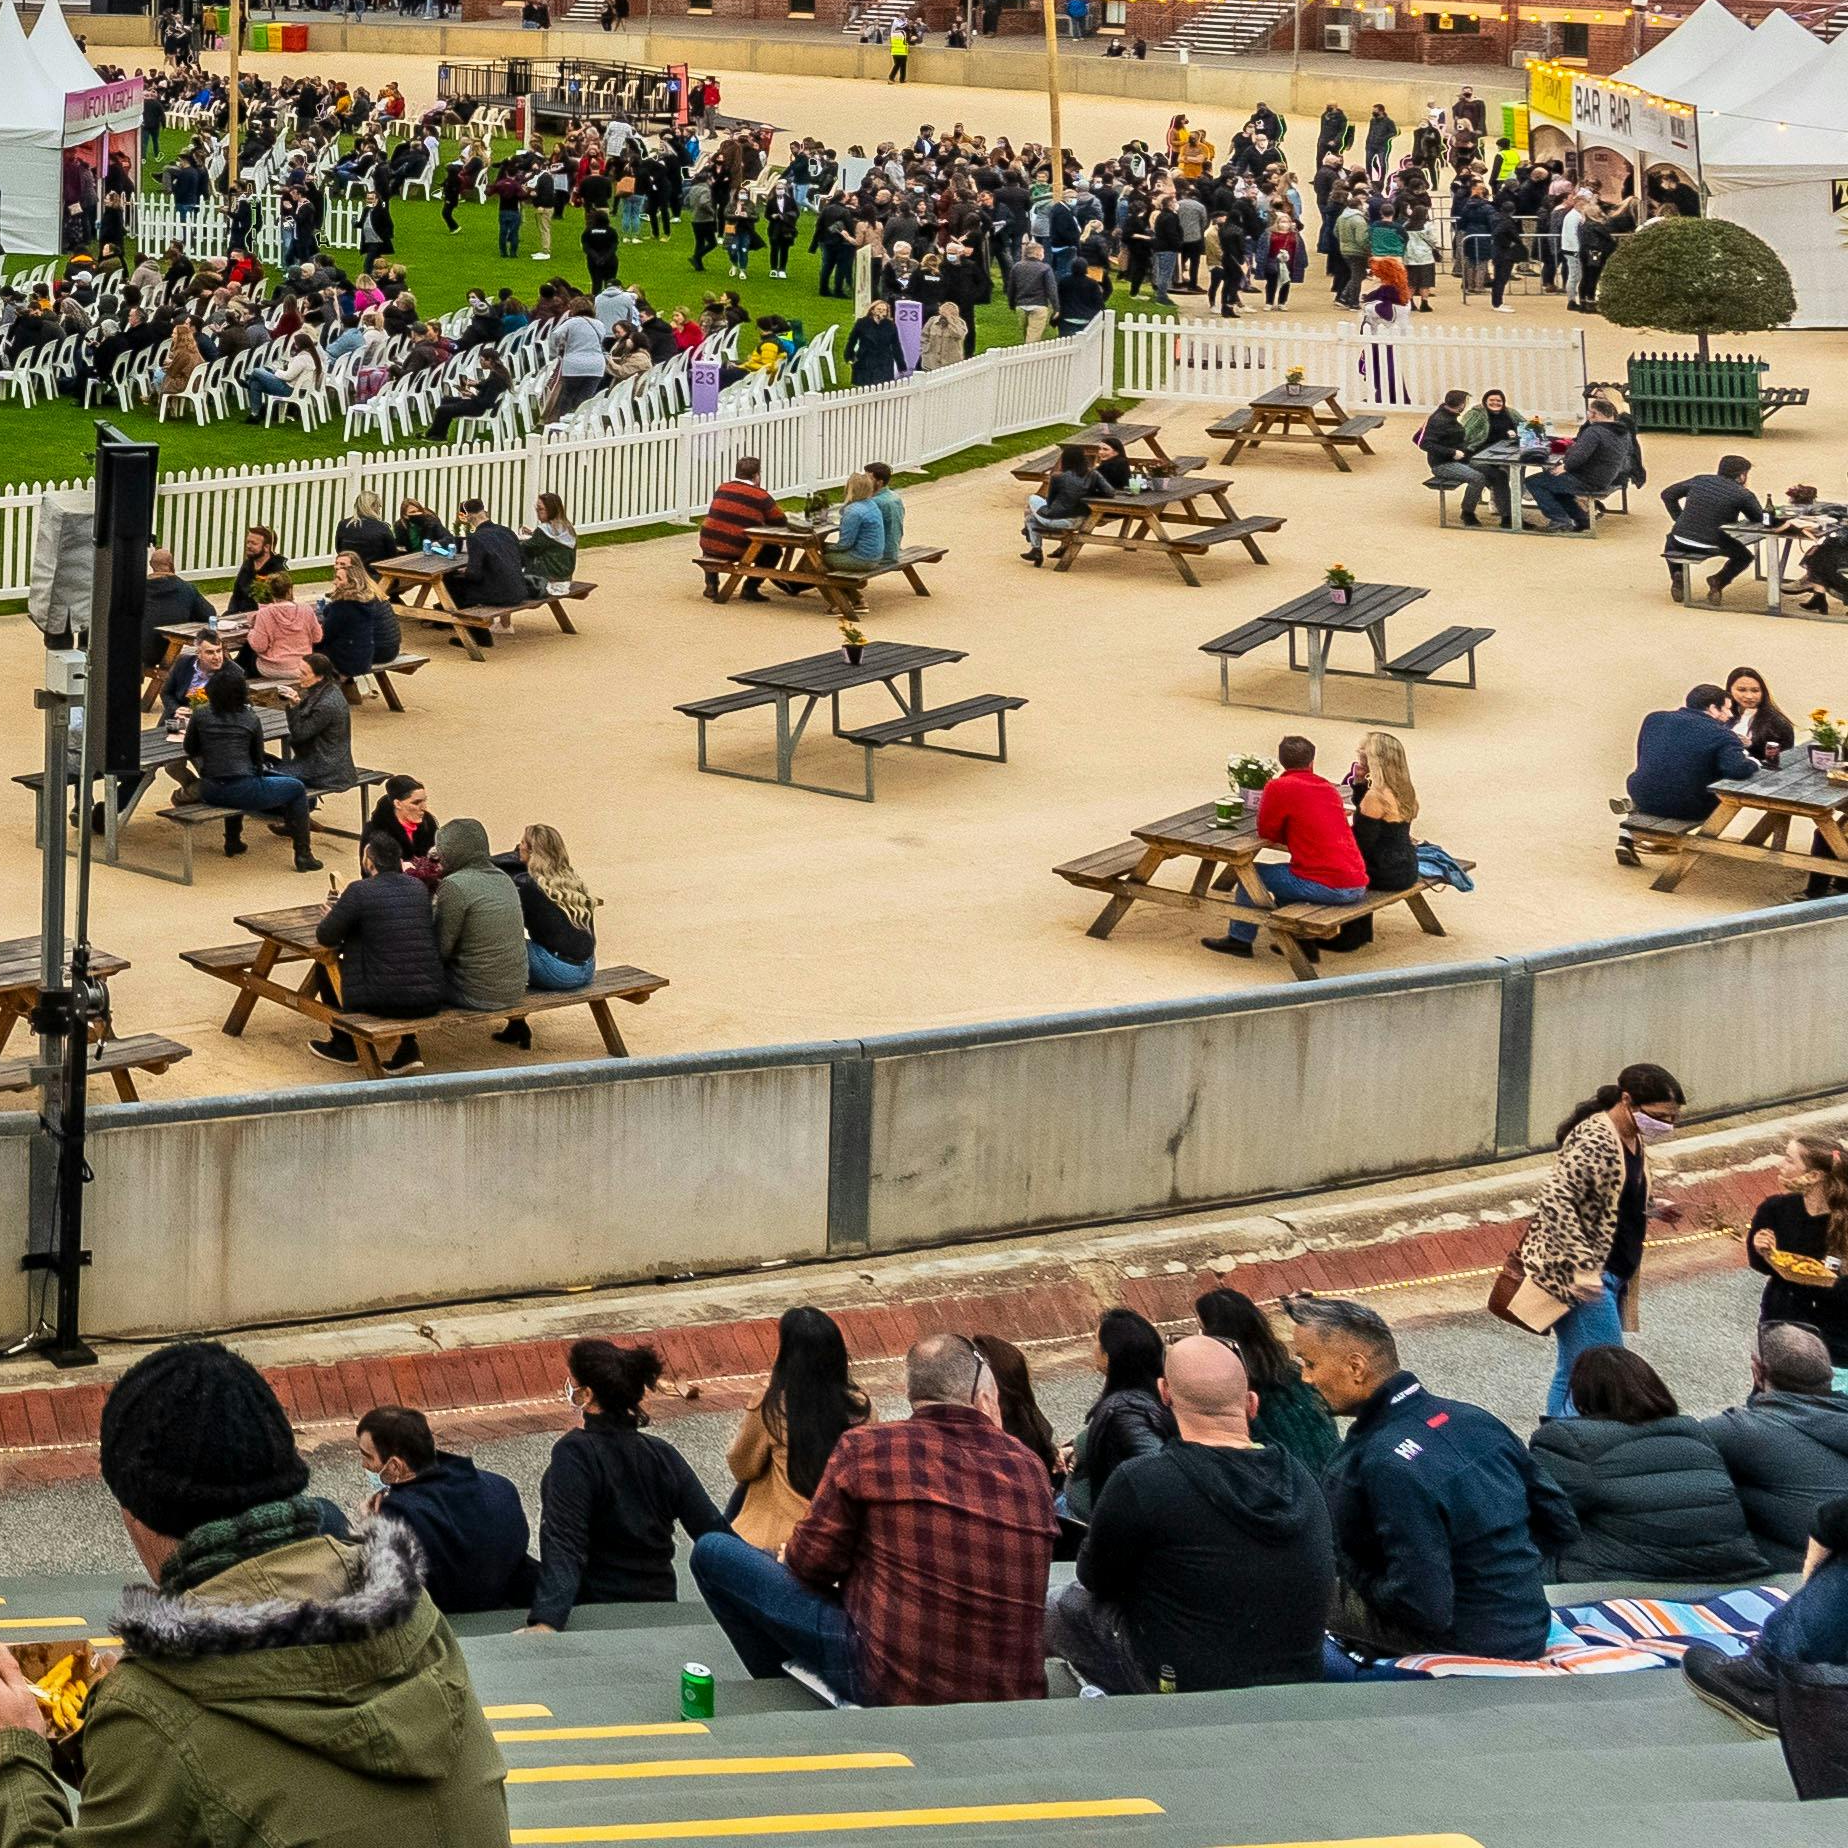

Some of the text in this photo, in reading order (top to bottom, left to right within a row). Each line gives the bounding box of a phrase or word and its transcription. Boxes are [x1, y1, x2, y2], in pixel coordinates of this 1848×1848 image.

[1575, 85, 1602, 127] BAR
[1610, 93, 1633, 137] BAR
[899, 309, 919, 322] 23
[695, 370, 715, 385] 23
